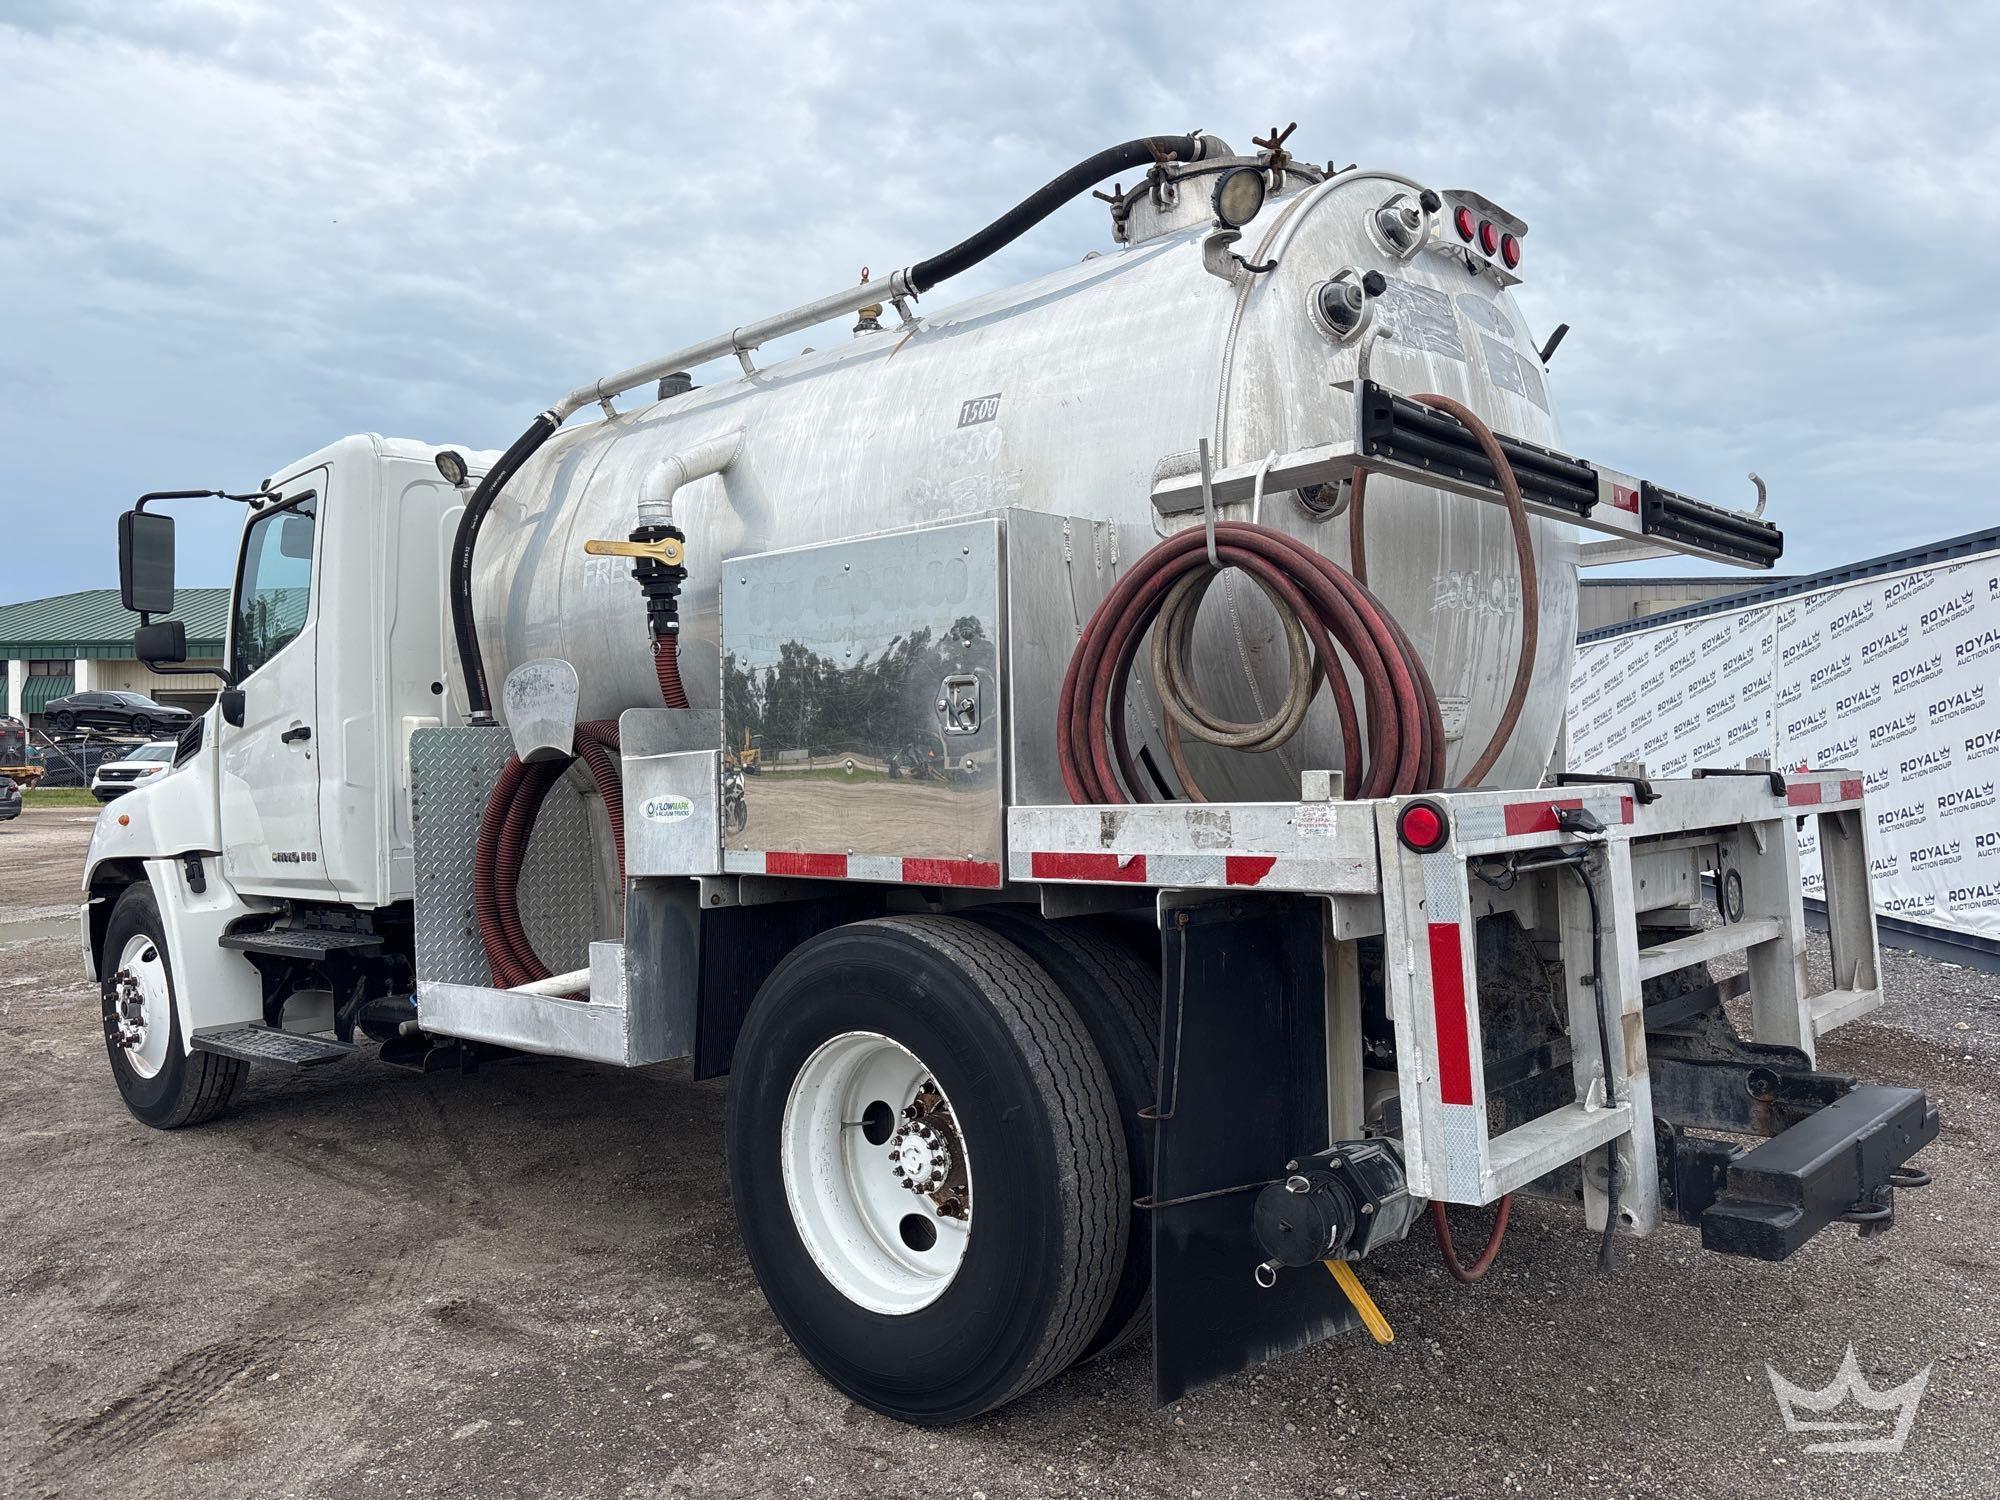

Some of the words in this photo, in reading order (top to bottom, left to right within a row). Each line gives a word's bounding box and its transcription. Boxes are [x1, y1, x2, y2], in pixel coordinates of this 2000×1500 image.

[962, 398, 998, 424] 1500
[1884, 572, 1923, 601] ROYAL
[1887, 590, 1913, 610] AUCTION
[1913, 578, 1934, 595] GROUP
[1830, 607, 1864, 632] ROYAL
[1920, 598, 1963, 627] ROYAL
[1923, 617, 1951, 636] AUCTION
[1951, 604, 1975, 621] GROUP
[1832, 623, 1855, 640] AUCTION
[1855, 612, 1873, 627] GROUP
[1654, 634, 1673, 653] ROYAL
[1702, 631, 1725, 652] ROYAL
[1783, 637, 1813, 660] ROYAL
[1862, 632, 1898, 657] ROYAL
[1864, 649, 1888, 666] AUCTION
[1889, 638, 1909, 653] GROUP
[1955, 628, 2000, 657] ROYAL
[1670, 654, 1690, 673] ROYAL
[1723, 652, 1747, 672] ROYAL
[1958, 648, 1989, 667] AUCTION
[1810, 661, 1842, 684] ROYAL
[1813, 677, 1834, 692] AUCTION
[1834, 667, 1851, 681] GROUP
[1892, 661, 1932, 687] ROYAL
[1894, 679, 1921, 695] AUCTION
[1921, 668, 1943, 683] GROUP
[1689, 675, 1710, 693] ROYAL
[1742, 676, 1768, 696] ROYAL
[1777, 687, 1793, 701] YAL
[1658, 695, 1677, 712] ROYAL
[1706, 698, 1729, 716] ROYAL
[1837, 689, 1871, 712] ROYAL
[1839, 705, 1862, 720] AUCTION
[1862, 696, 1881, 709] GROUP
[1929, 691, 1972, 717] ROYAL
[1932, 709, 1961, 726] AUCTION
[1961, 699, 1985, 714] GROUP
[1674, 717, 1694, 734] ROYAL
[1727, 721, 1752, 740] ROYAL
[1789, 714, 1819, 734] ROYAL
[1869, 718, 1906, 741] ROYAL
[1871, 735, 1896, 749] AUCTION
[1896, 726, 1917, 739] GROUP
[1693, 740, 1715, 757] ROYAL
[1817, 741, 1849, 761] ROYAL
[1968, 745, 2000, 761] AUCTION
[1662, 757, 1681, 772] ROYAL
[1900, 752, 1940, 774] ROYAL
[1902, 768, 1929, 783] AUCTION
[1929, 760, 1952, 773] GROUP
[1938, 787, 1982, 809] ROYAL
[1941, 804, 1970, 818] AUCTION
[1970, 797, 1995, 810] GROUP
[1877, 806, 1916, 826] ROYAL
[1909, 844, 1951, 863] ROYAL
[1979, 846, 2000, 857] AUCTI
[1912, 860, 1940, 872] AUCTION
[1940, 855, 1963, 866] GROUP
[1885, 896, 1923, 912] ROYAL
[1948, 885, 1994, 903] ROYAL
[1951, 901, 1981, 912] AUCTION
